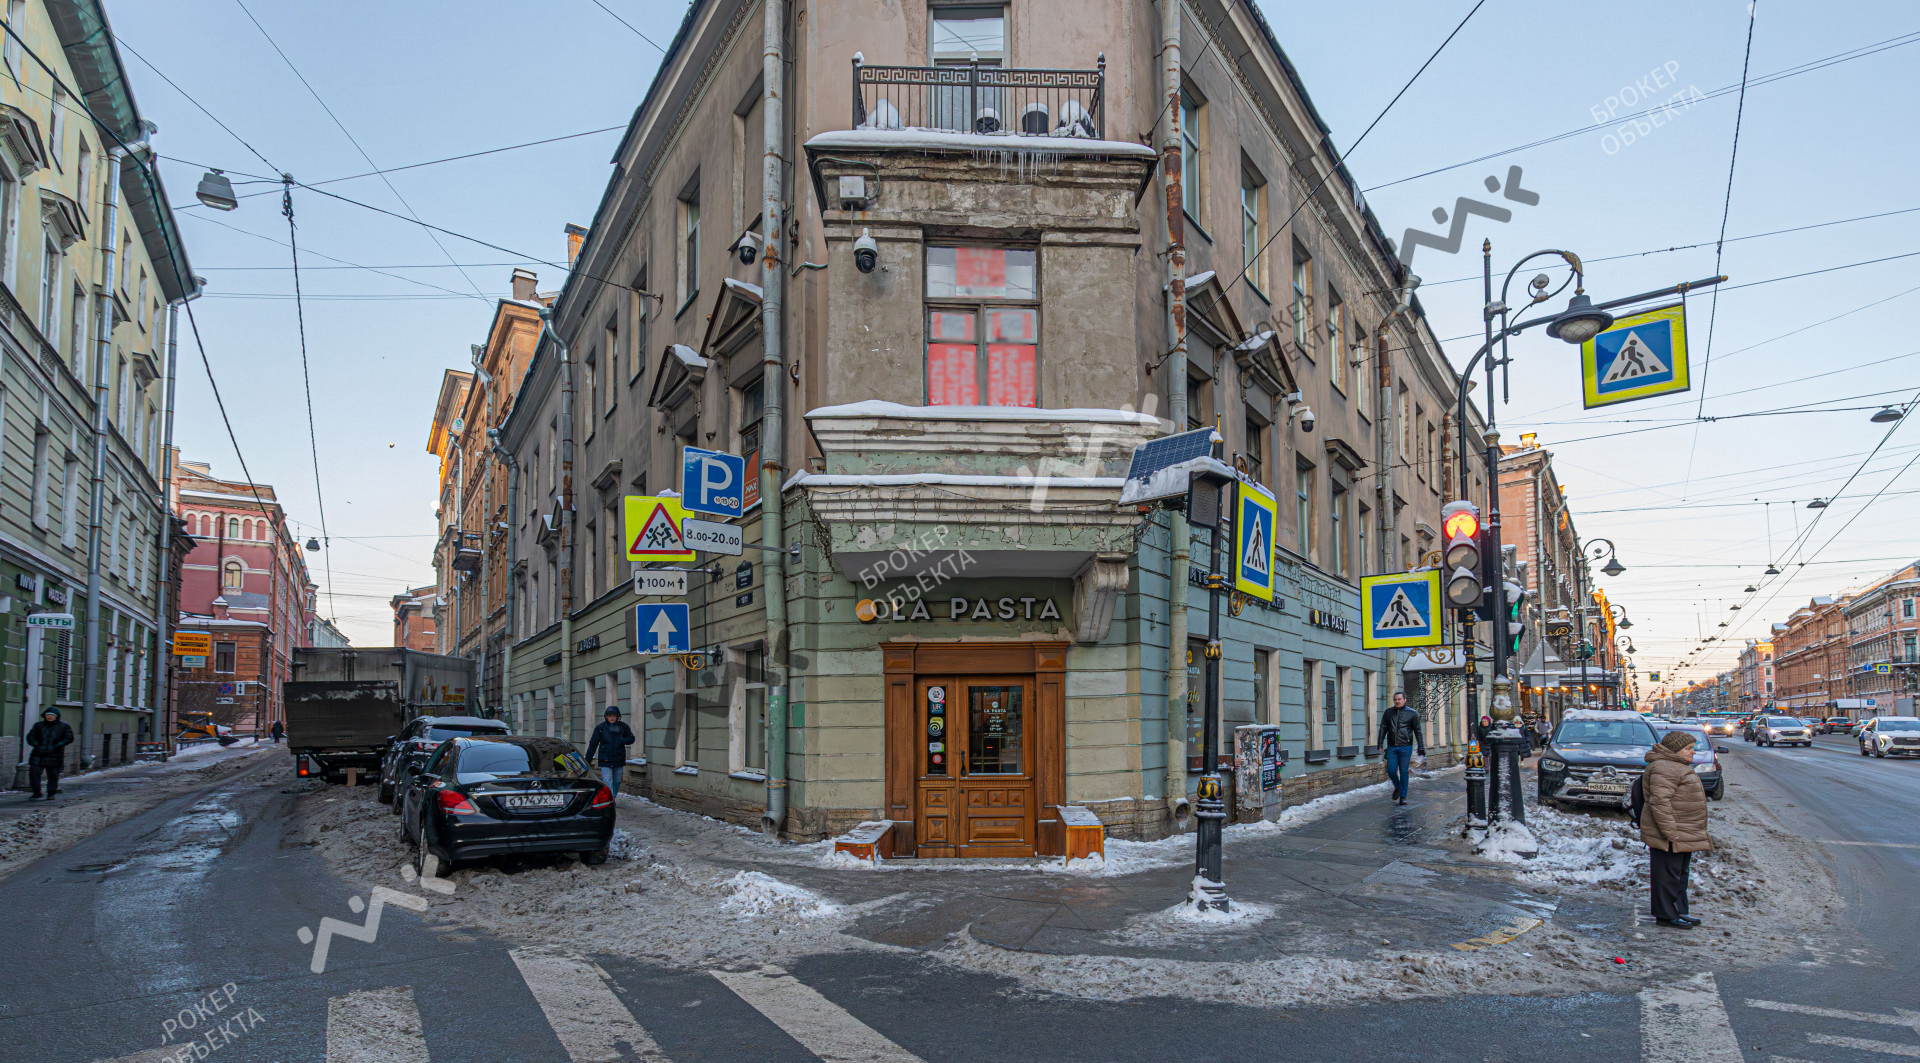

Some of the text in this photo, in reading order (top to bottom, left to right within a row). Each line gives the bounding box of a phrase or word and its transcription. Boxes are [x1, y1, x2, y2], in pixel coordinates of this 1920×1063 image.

[700, 457, 733, 505] P
[729, 499, 739, 507] 20
[686, 528, 740, 546] 8.00-20.00
[892, 597, 1060, 621] LA PASTA
[28, 617, 72, 626] ЦВЕТЫ
[1321, 611, 1349, 632] LA PASTA
